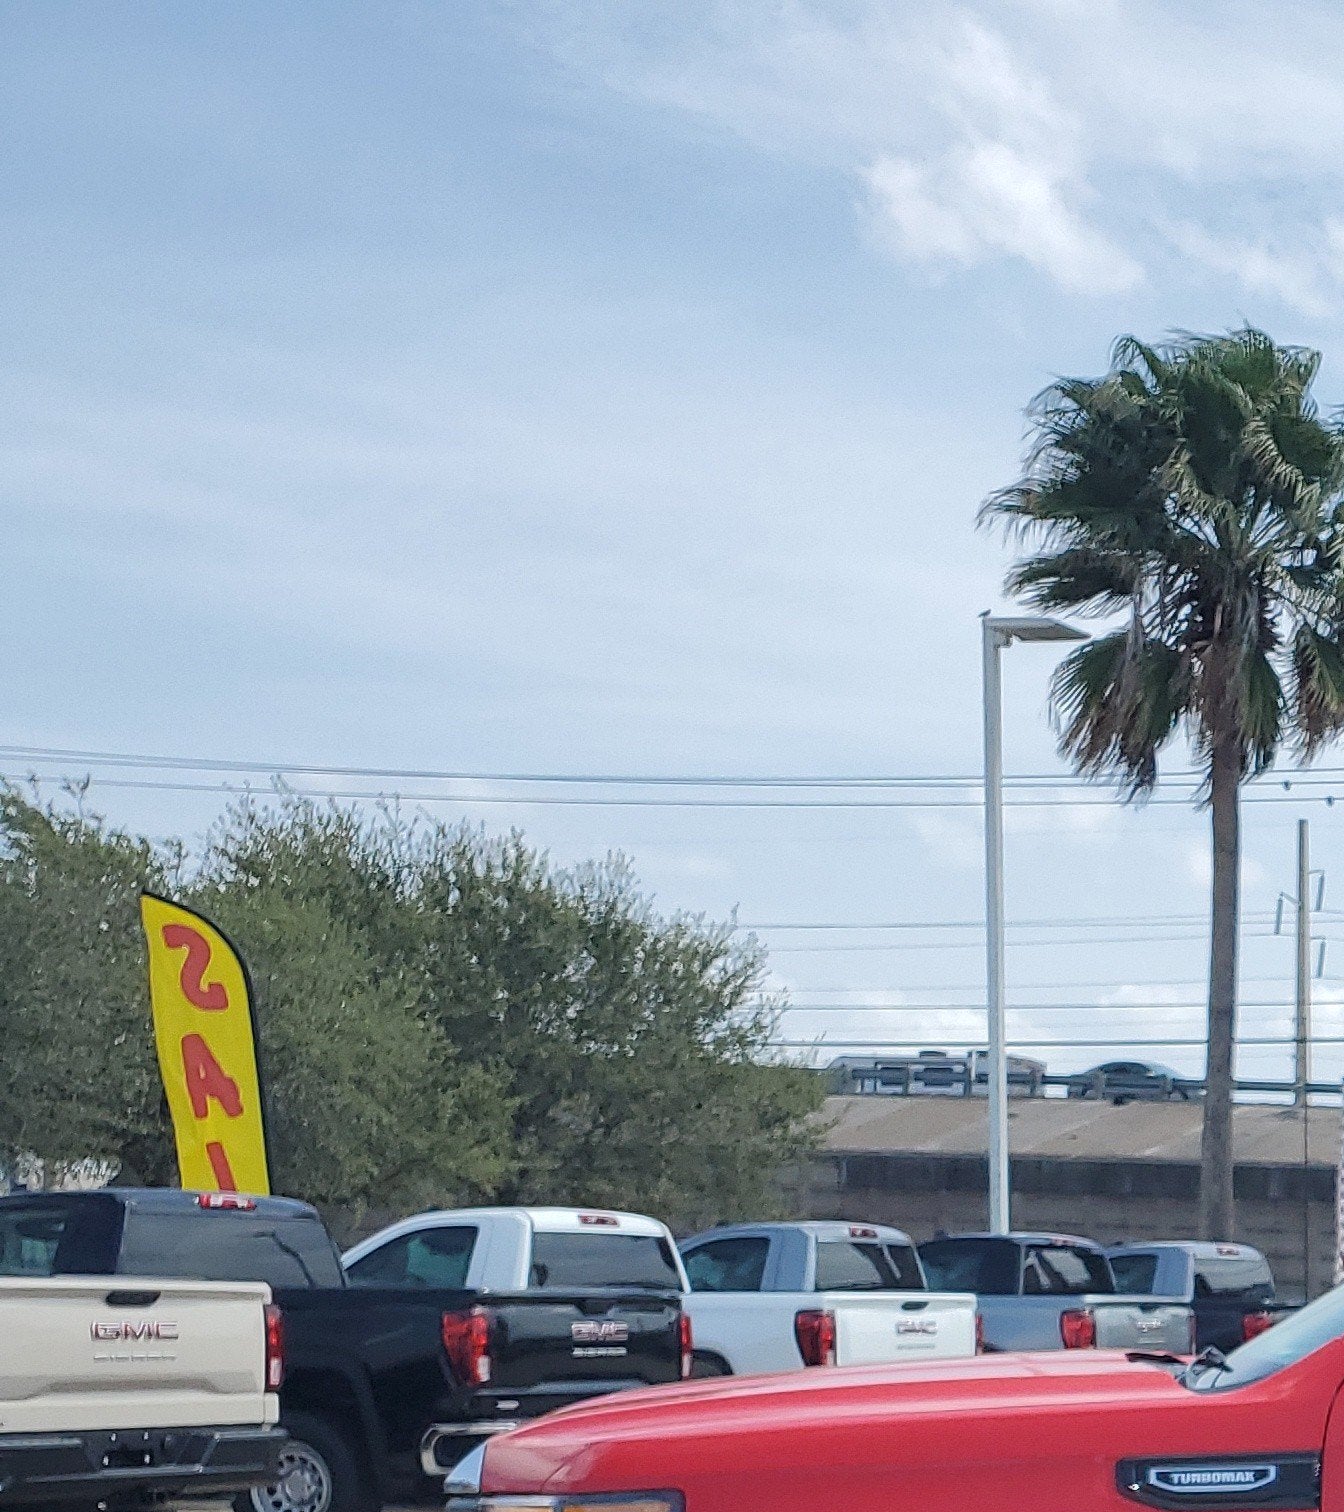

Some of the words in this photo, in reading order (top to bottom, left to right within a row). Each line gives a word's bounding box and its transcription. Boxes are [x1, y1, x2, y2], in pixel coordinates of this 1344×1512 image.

[90, 1321, 179, 1340] GMC
[571, 1321, 628, 1341] GMC
[1170, 1472, 1256, 1484] TURBOMAX
